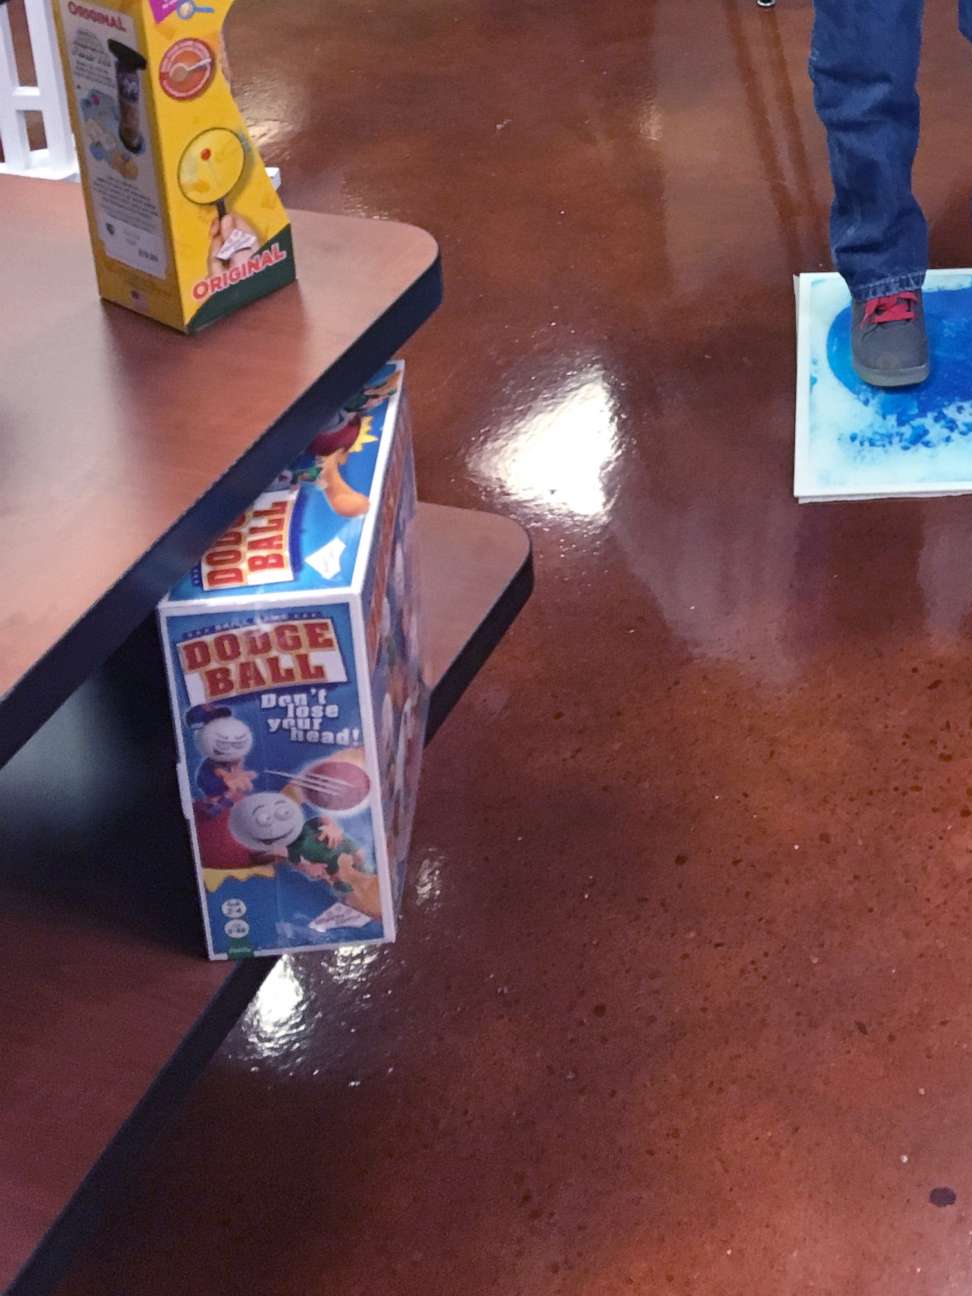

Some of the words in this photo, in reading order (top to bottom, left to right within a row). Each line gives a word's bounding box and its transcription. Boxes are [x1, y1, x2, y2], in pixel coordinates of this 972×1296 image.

[67, 1, 127, 33] ORIGINAL
[192, 243, 287, 301] ORIGINAL
[247, 501, 289, 571] BALL
[182, 621, 336, 671] DODGE
[204, 653, 327, 697] BALL
[261, 688, 328, 709] Don't
[286, 703, 339, 718] lose
[267, 718, 323, 733] your
[290, 728, 361, 747] head!
